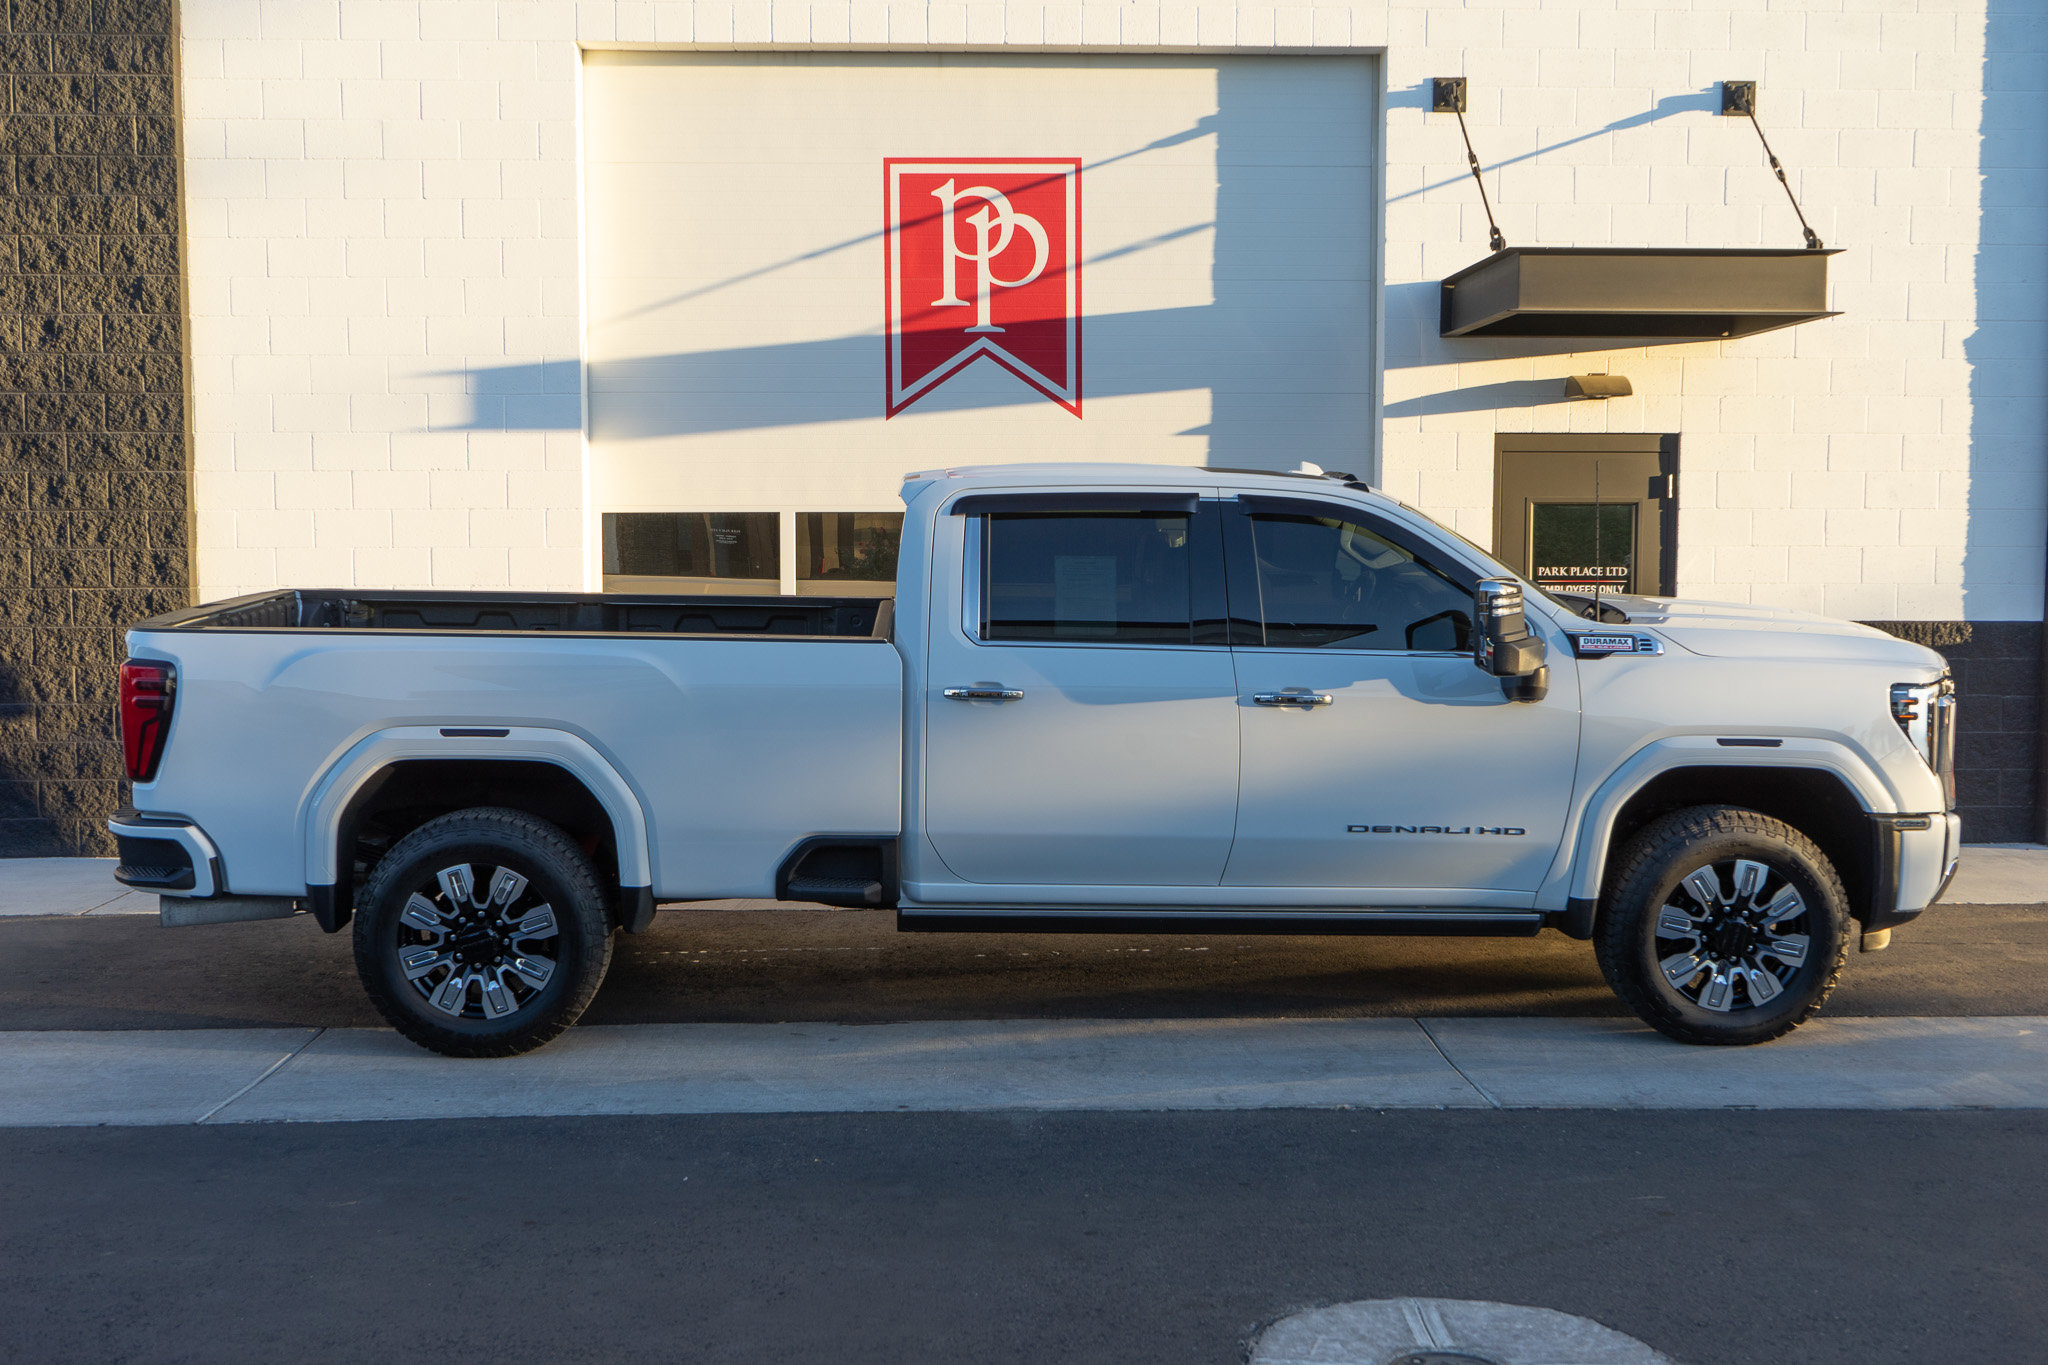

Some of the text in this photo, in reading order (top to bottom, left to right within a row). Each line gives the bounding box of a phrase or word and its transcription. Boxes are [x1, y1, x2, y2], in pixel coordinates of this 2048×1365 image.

[1538, 566, 1628, 576] PARK PLACE LTD
[1599, 585, 1625, 594] ONLY
[1583, 637, 1629, 645] DURAMAX
[1347, 825, 1526, 836] DENALI HD
